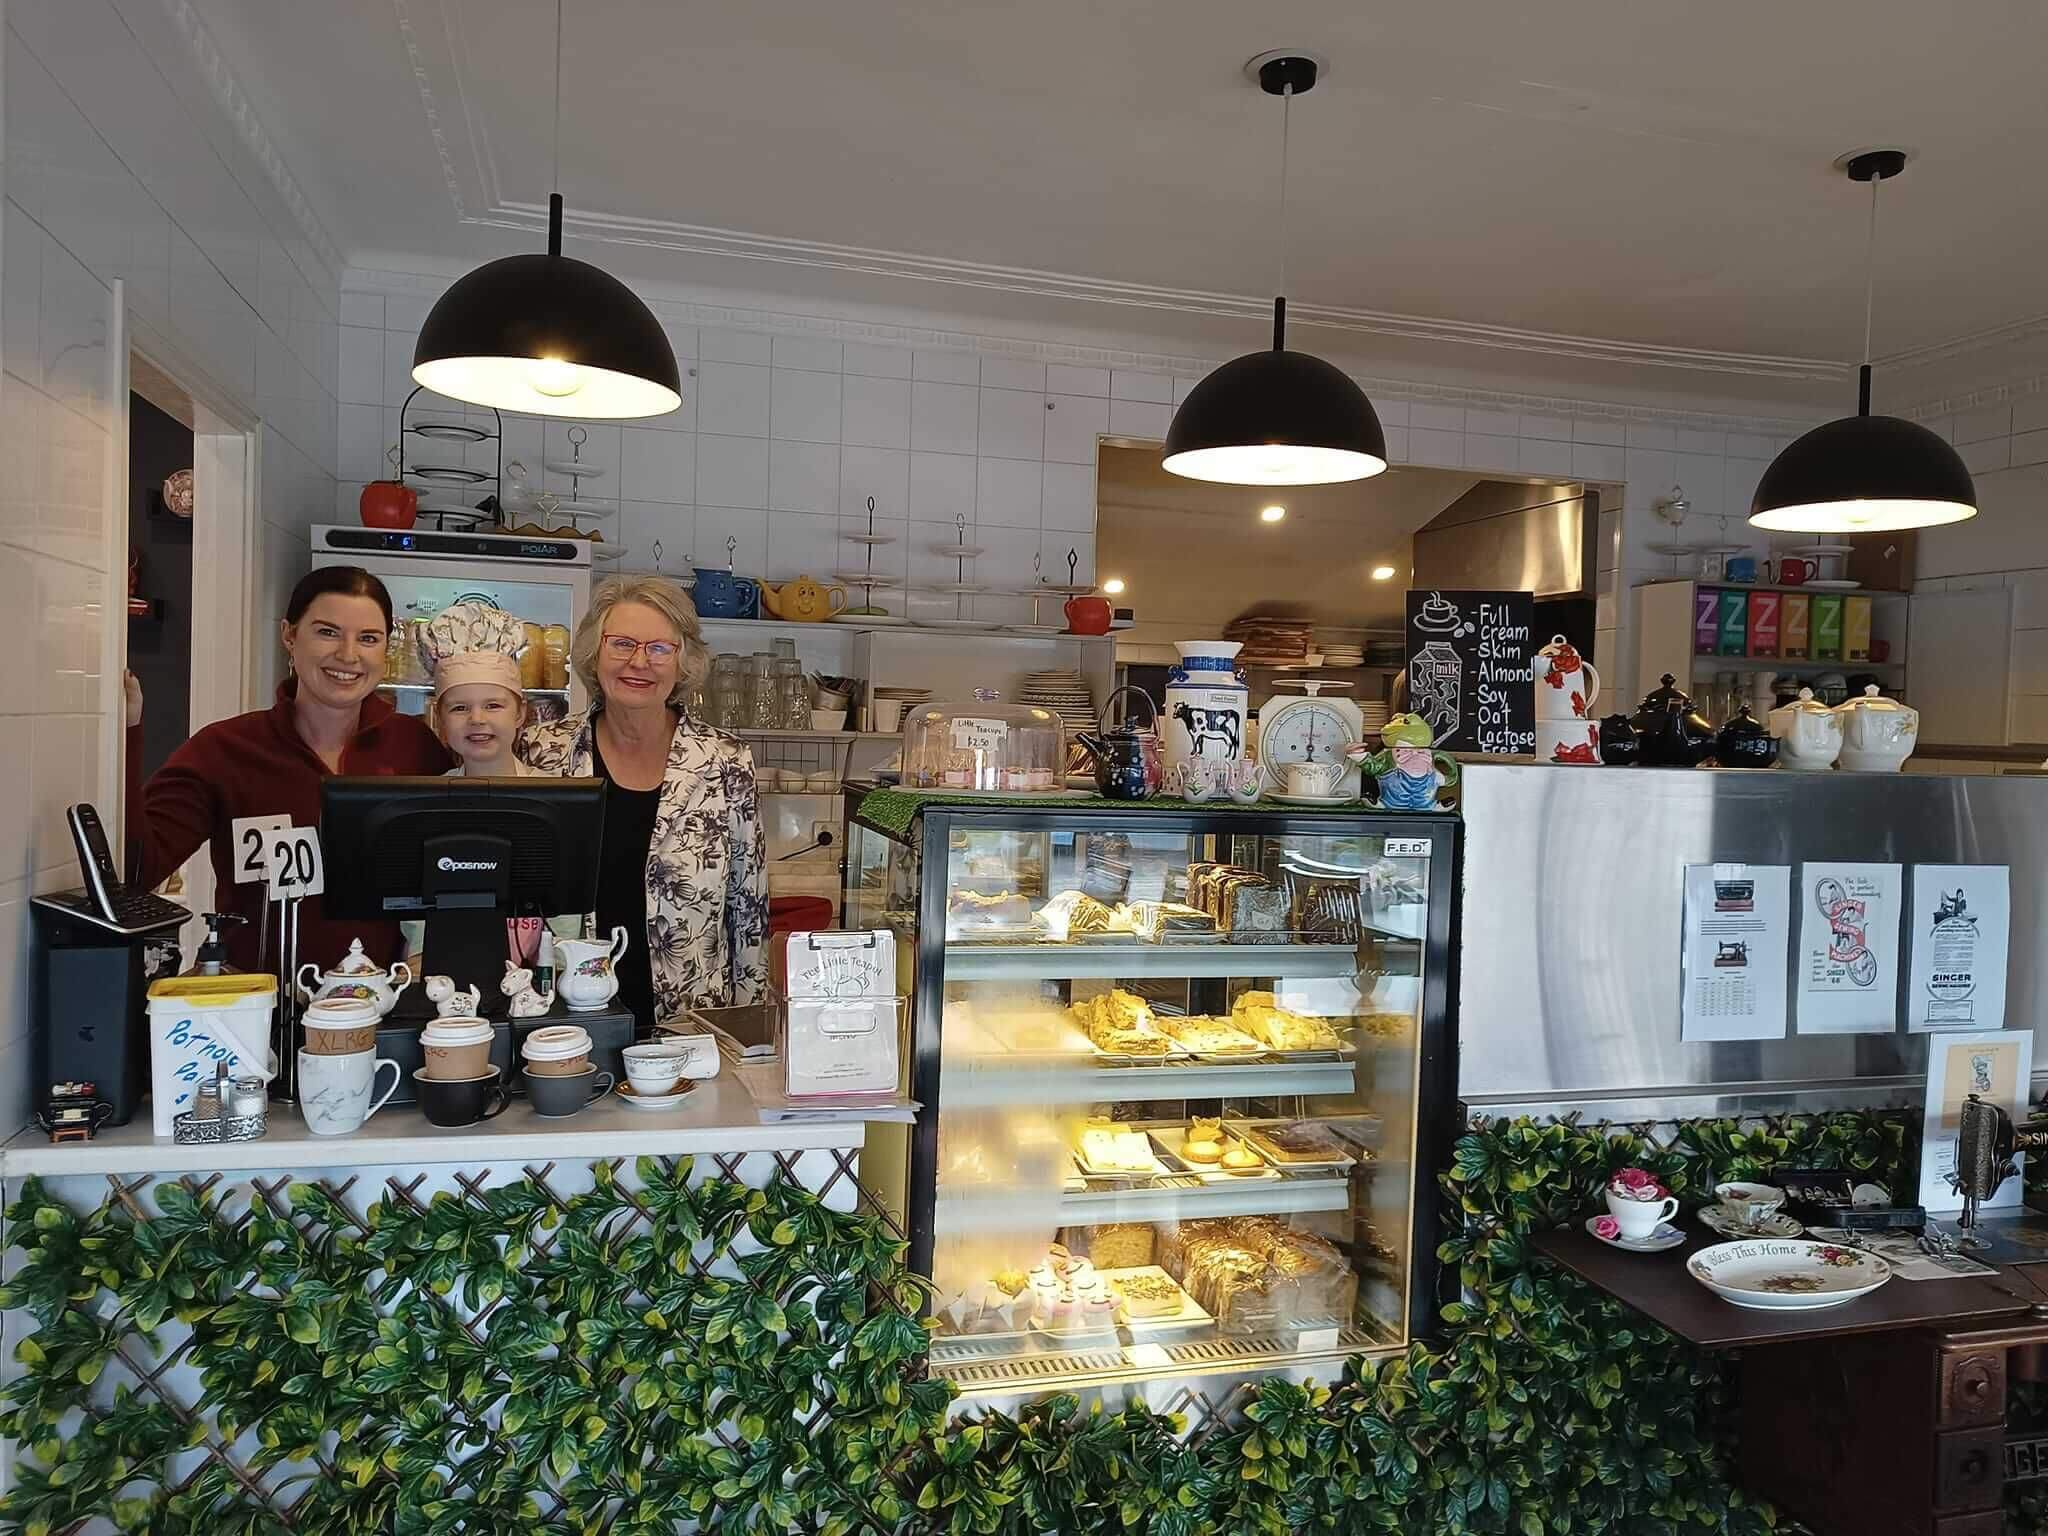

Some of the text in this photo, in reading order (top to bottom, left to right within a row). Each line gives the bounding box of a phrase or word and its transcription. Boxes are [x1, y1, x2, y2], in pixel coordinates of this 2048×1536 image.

[1480, 604, 1510, 626] Full
[1697, 594, 1719, 629] Z
[1725, 596, 1745, 631] Z
[1755, 598, 1777, 632] Z
[1788, 599, 1809, 634] Z
[1819, 600, 1840, 635] Z
[1481, 625, 1529, 641] Cream
[1478, 640, 1520, 659] Skim
[1436, 663, 1459, 675] milk
[1478, 657, 1534, 683] Almond
[1478, 684, 1507, 709] Soy
[1478, 702, 1512, 725] Oat
[1478, 725, 1535, 746] Lactose
[275, 839, 314, 887] 20
[1932, 974, 1971, 982] SINGER
[1759, 1243, 1797, 1256] Home
